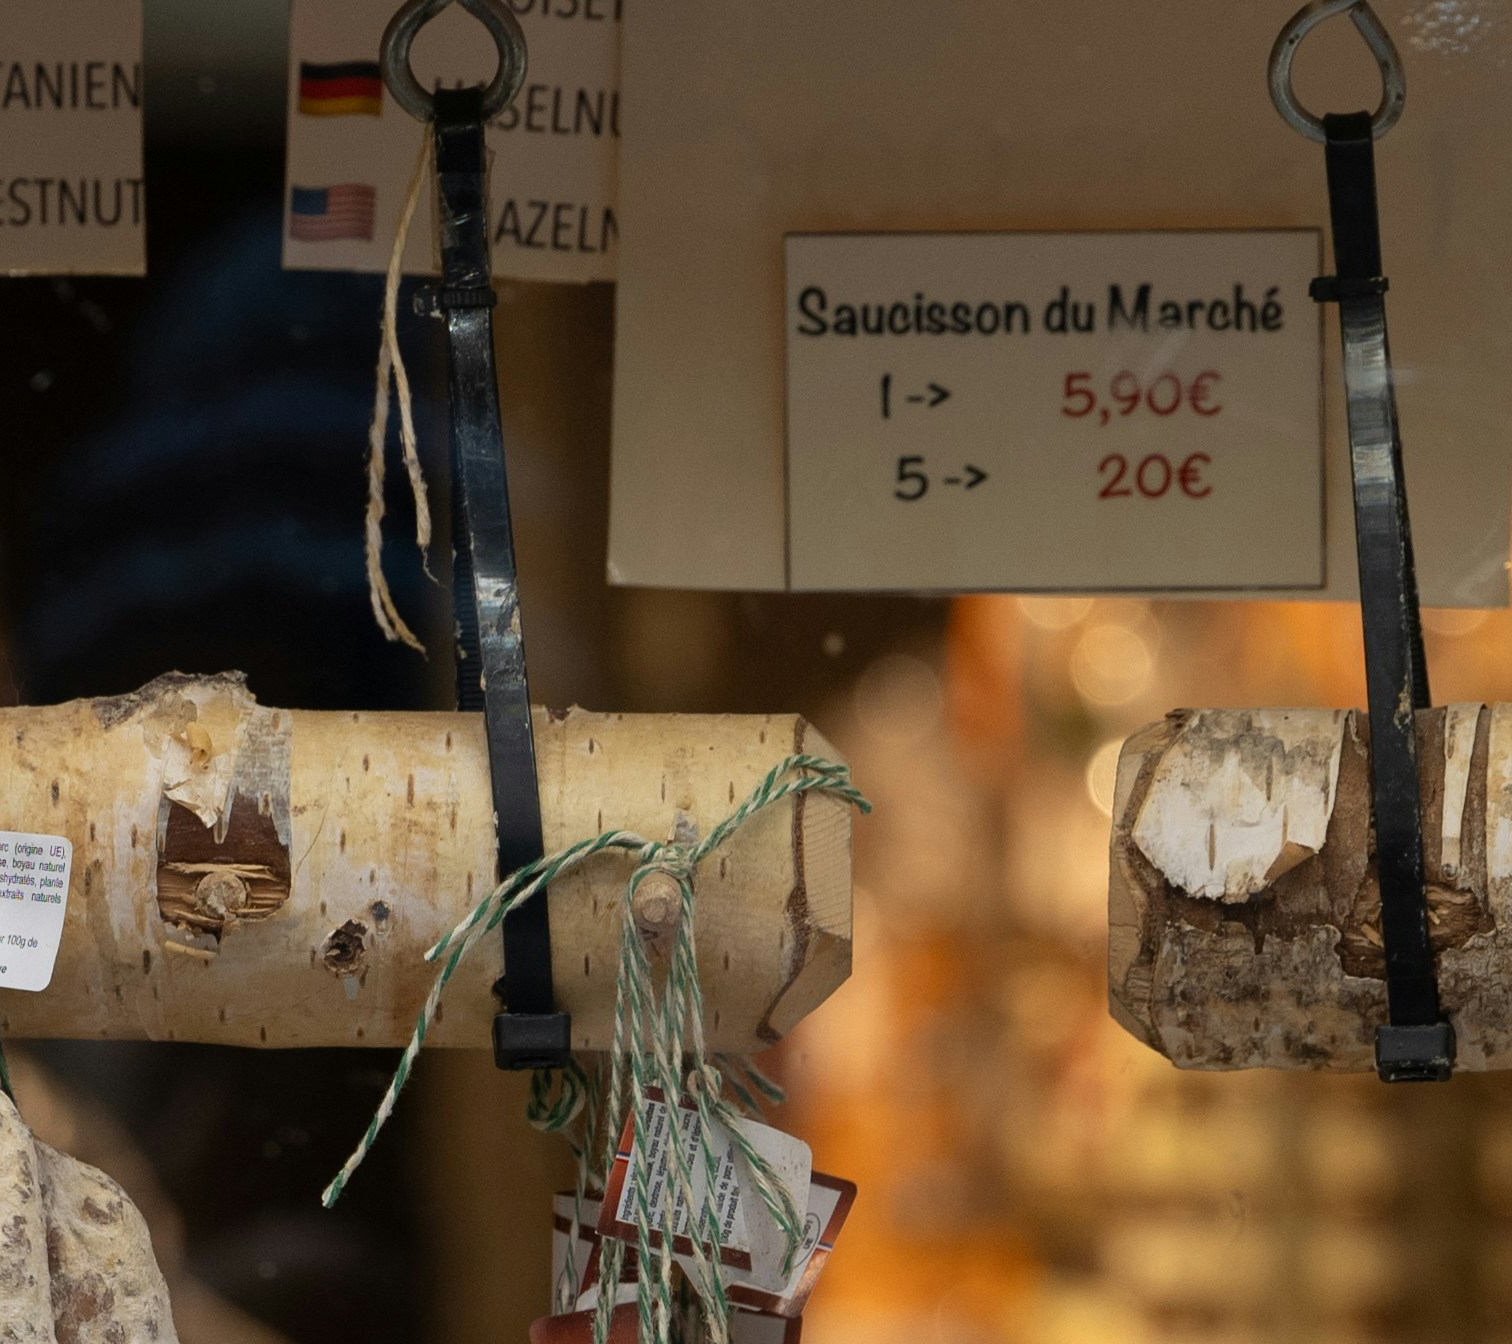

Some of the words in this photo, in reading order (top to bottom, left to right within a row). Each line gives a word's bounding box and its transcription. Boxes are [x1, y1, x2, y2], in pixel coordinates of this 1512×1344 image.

[796, 285, 1031, 337] Saucisson
[1043, 285, 1097, 335] du
[1106, 283, 1284, 334] Marché
[1061, 371, 1224, 426] 5,90€
[894, 456, 930, 502] 5
[1096, 453, 1213, 501] 20€
[14, 842, 44, 857] (origine
[12, 857, 36, 872] boyau
[38, 860, 66, 873] naturel
[39, 877, 64, 890] plante
[31, 891, 62, 905] naturels
[7, 934, 27, 949] 100g
[27, 937, 38, 949] de
